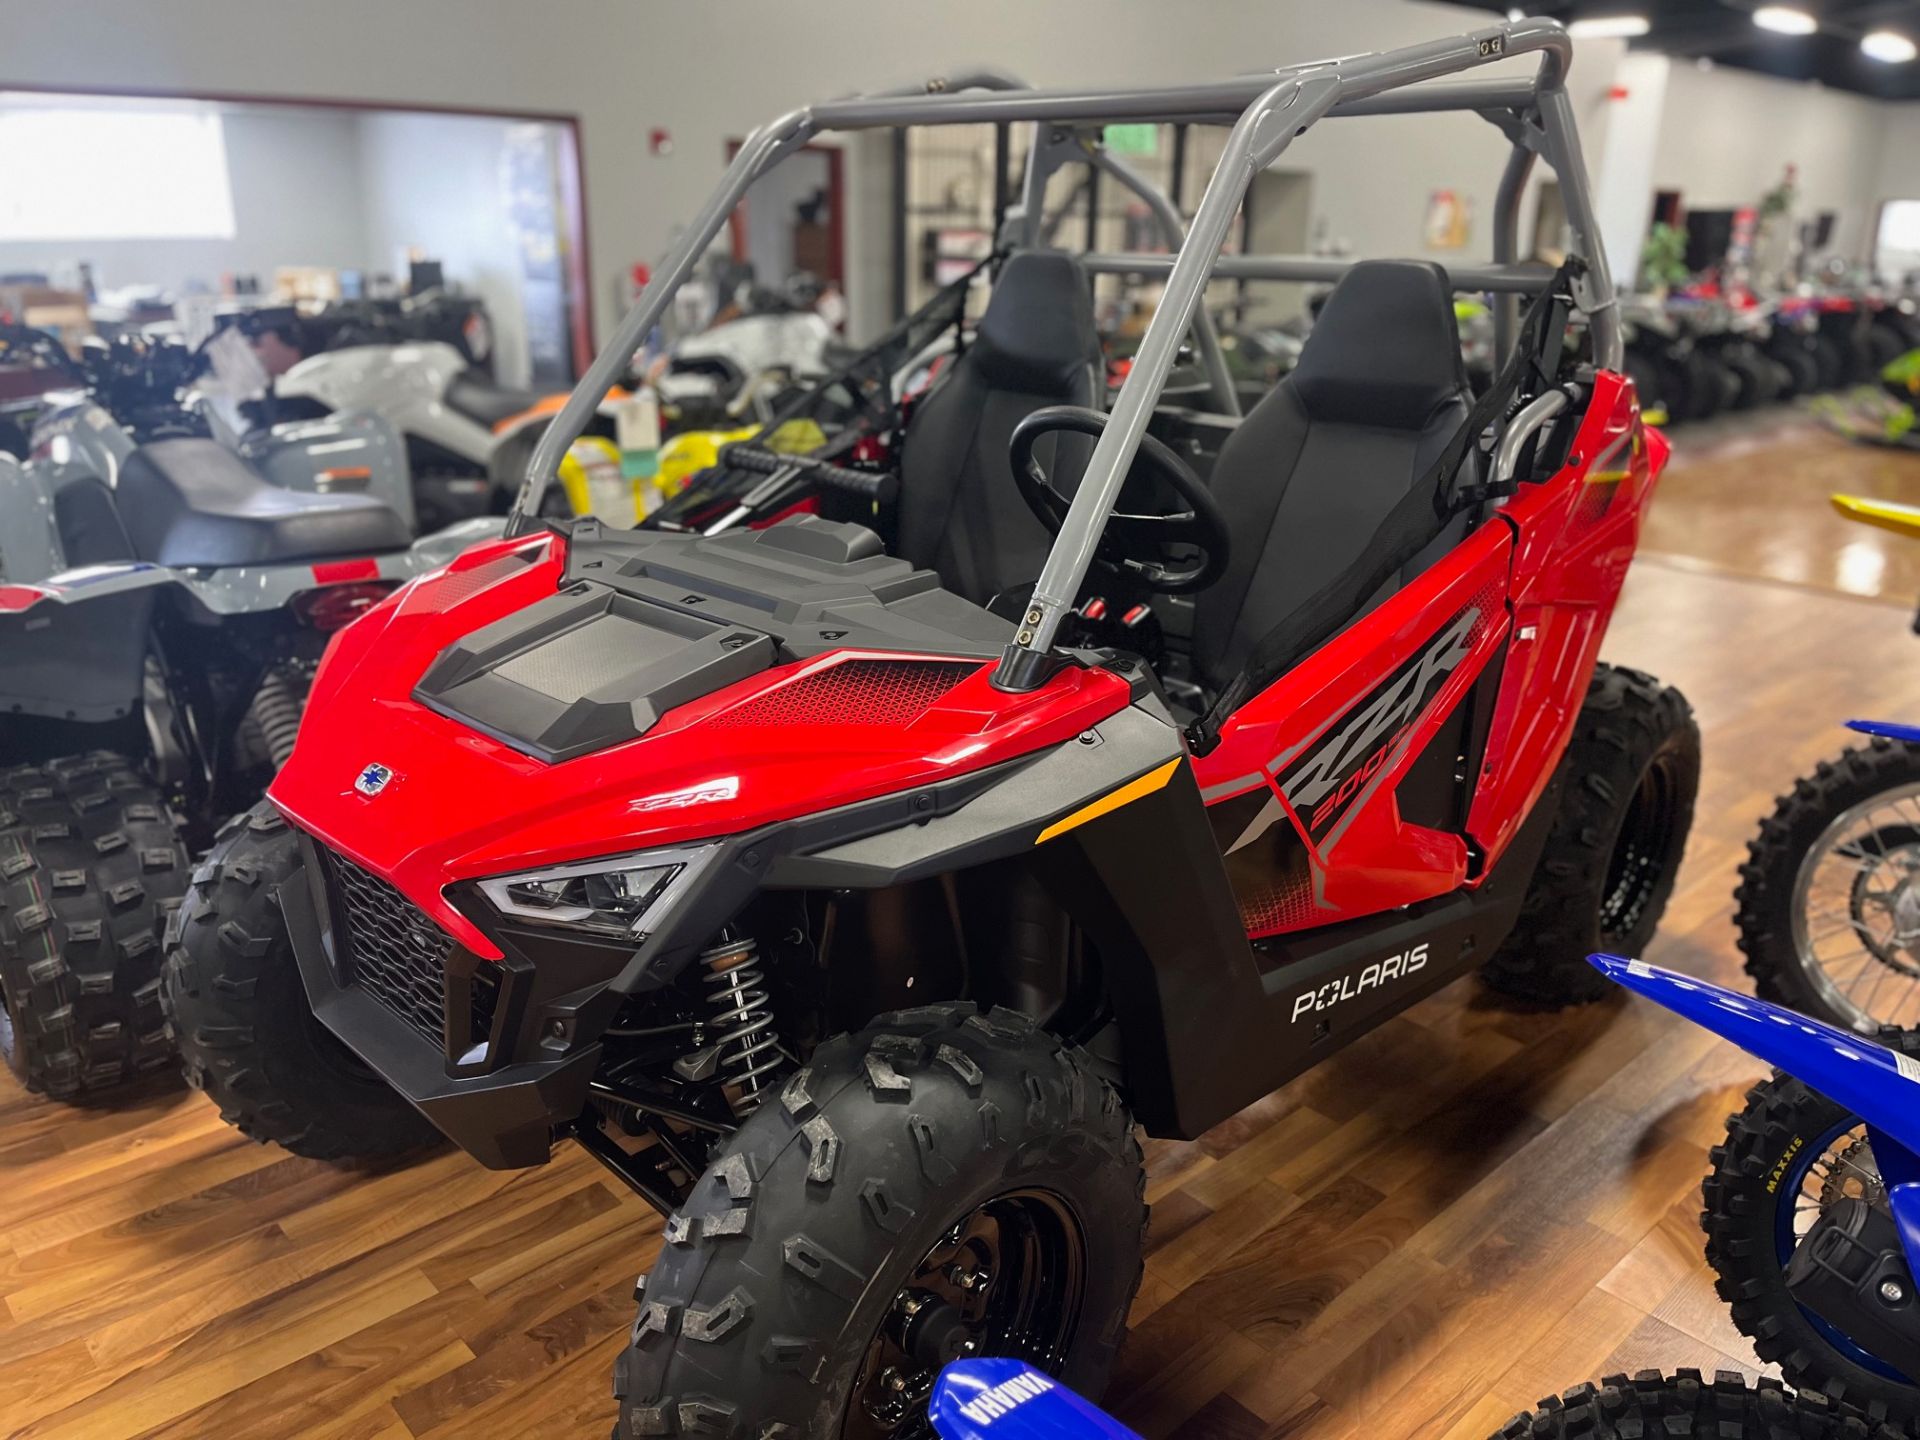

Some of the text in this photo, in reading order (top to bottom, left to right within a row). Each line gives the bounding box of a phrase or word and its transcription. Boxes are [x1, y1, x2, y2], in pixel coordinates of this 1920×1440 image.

[1224, 608, 1480, 857] RZR
[1290, 943, 1430, 1024] POLARIS
[1766, 1137, 1804, 1194] MAXXIS
[960, 1371, 1055, 1426] YAMAHA
